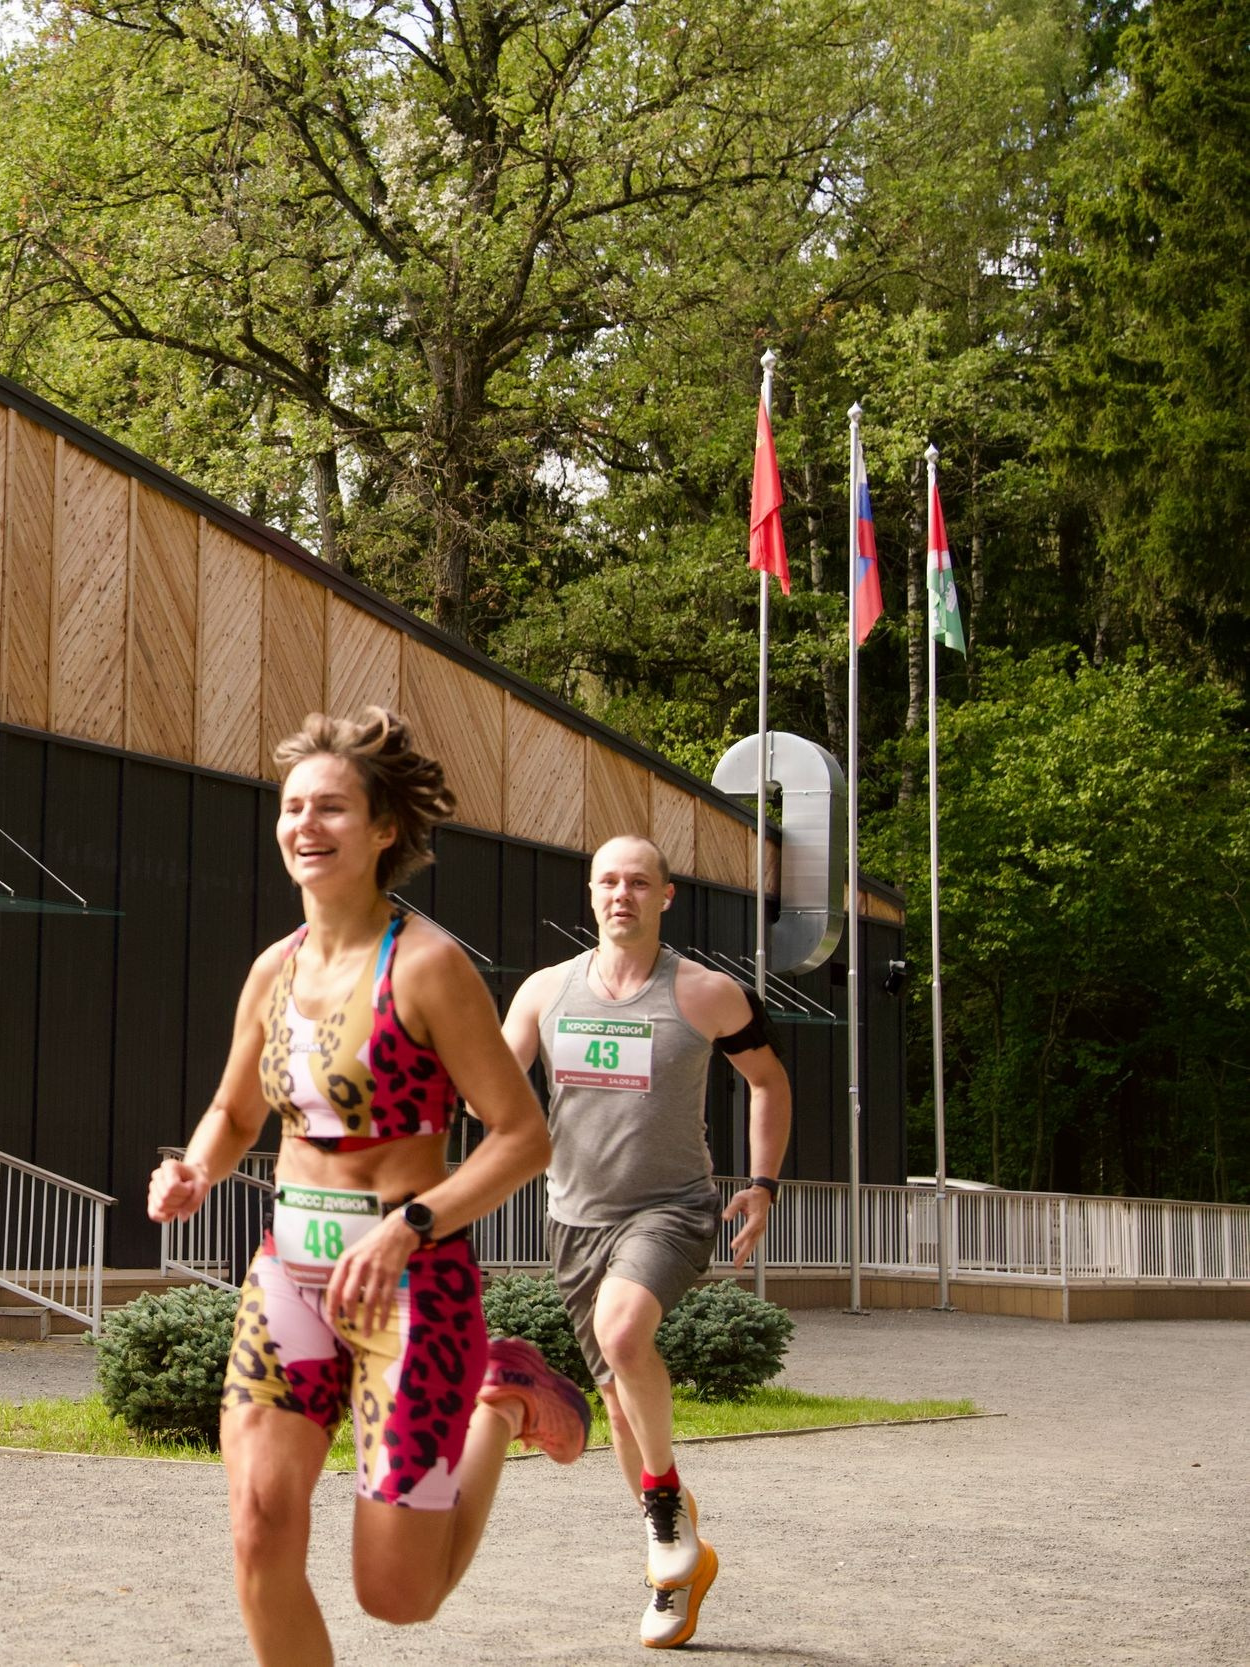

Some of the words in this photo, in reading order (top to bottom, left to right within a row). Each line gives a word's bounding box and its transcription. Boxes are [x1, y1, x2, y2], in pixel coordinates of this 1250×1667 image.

[566, 1022, 604, 1032] КРОСС
[606, 1024, 643, 1035] ДУБКИ
[584, 1040, 619, 1069] 43
[304, 1219, 344, 1260] 48
